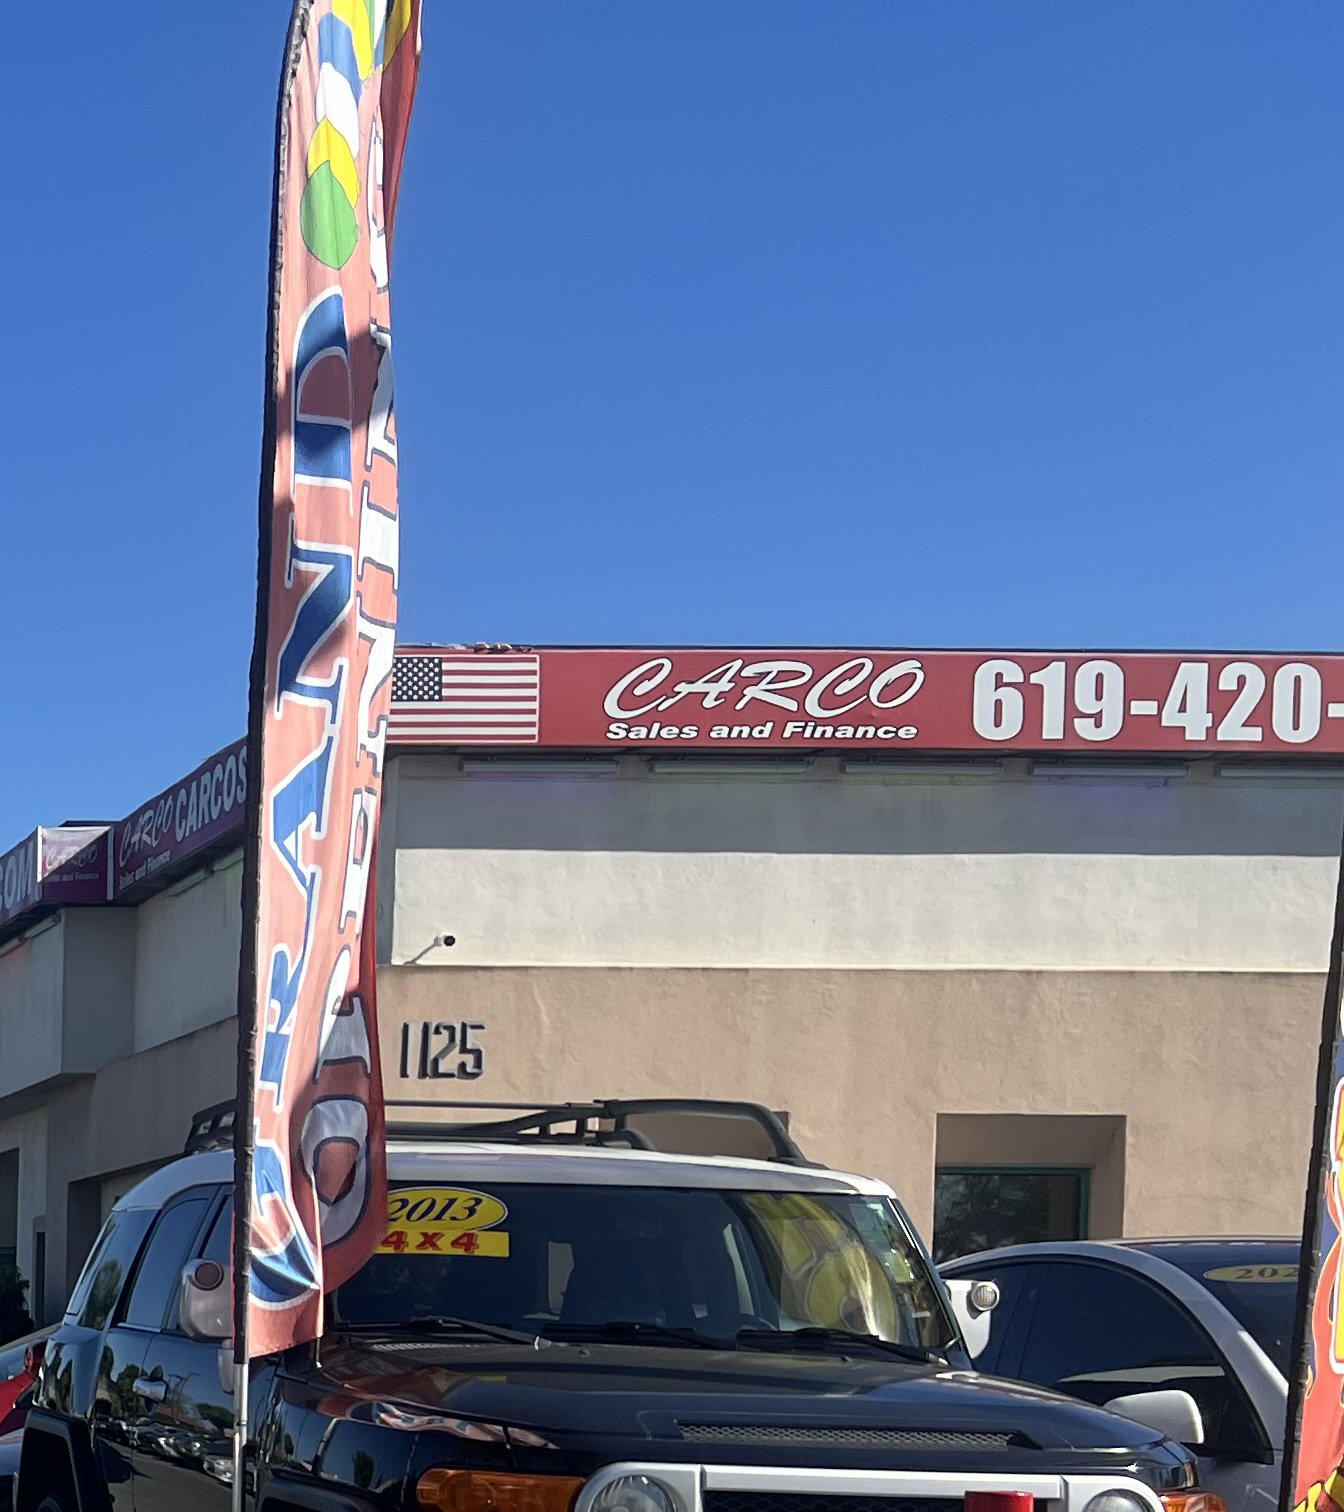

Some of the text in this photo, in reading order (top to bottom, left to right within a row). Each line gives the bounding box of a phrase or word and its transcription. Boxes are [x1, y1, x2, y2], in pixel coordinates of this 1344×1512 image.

[603, 657, 925, 719] CARCO
[973, 659, 1344, 743] 619-420-
[605, 721, 918, 740] Sales and Finance
[248, 285, 354, 1309] GRAND
[119, 795, 173, 868] CARCO
[400, 1021, 486, 1080] 1125
[388, 1197, 483, 1222] 2013
[1235, 1266, 1297, 1280] 202
